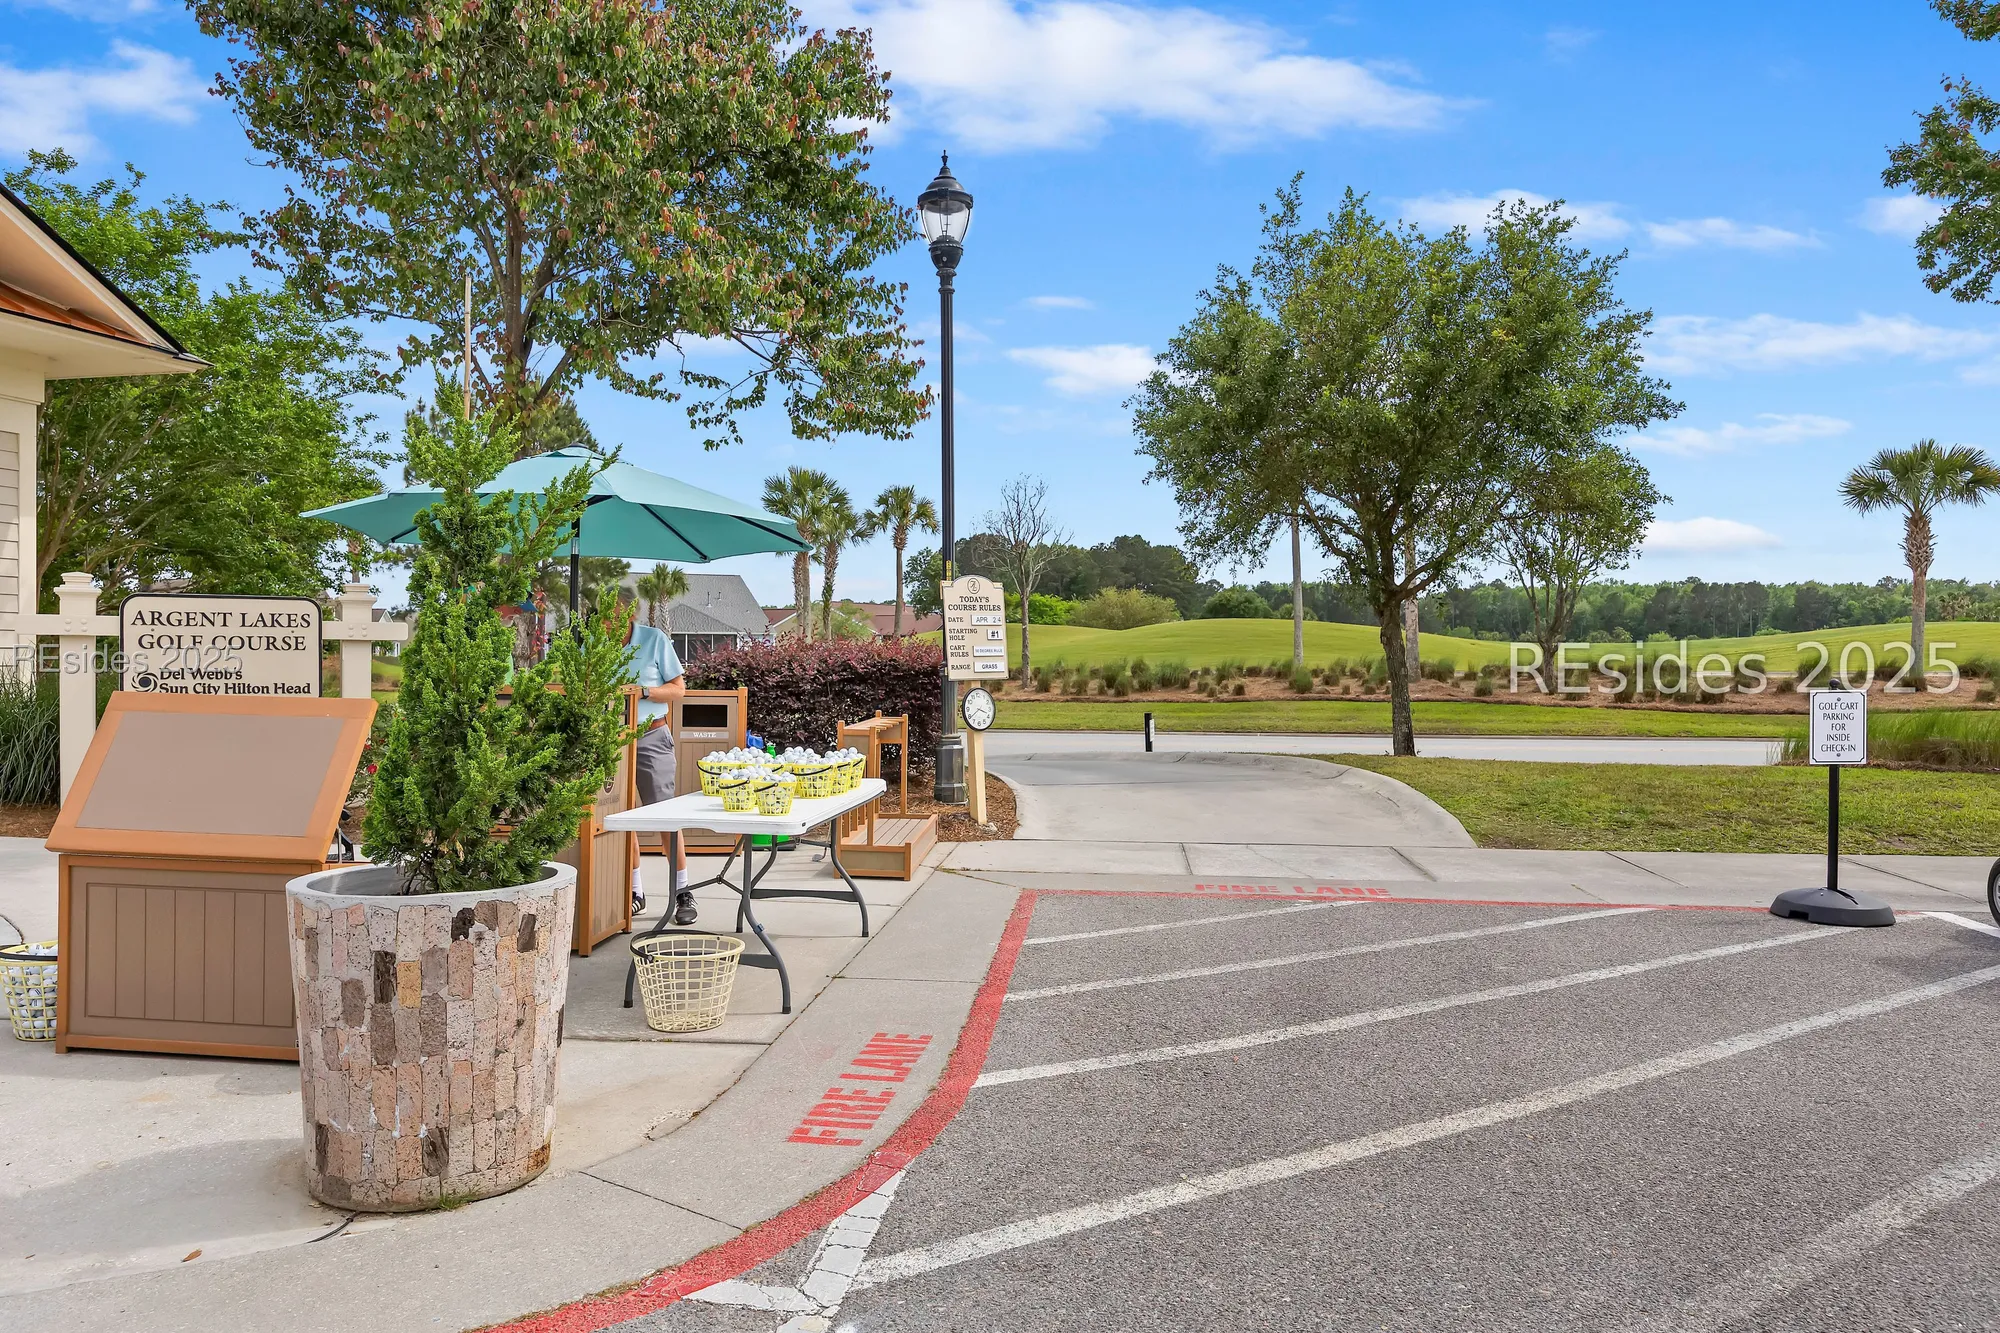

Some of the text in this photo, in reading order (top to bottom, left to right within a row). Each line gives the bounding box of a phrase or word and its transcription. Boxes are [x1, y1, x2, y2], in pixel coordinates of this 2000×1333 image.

[130, 610, 311, 628] ARGENT LAKES
[138, 634, 307, 651] GOLF COURSE
[159, 668, 243, 680] Del Webb's
[159, 683, 312, 695] Sun City Hilton Head
[1818, 702, 1859, 710] GOLF CART
[1823, 713, 1855, 721] PARKING
[1831, 723, 1846, 731] FOR
[1826, 733, 1850, 741] INSIDE
[1820, 744, 1856, 752] CHECK-IN
[1195, 884, 1391, 896] FIRE LANE
[788, 1032, 933, 1147] FIRE LANE
